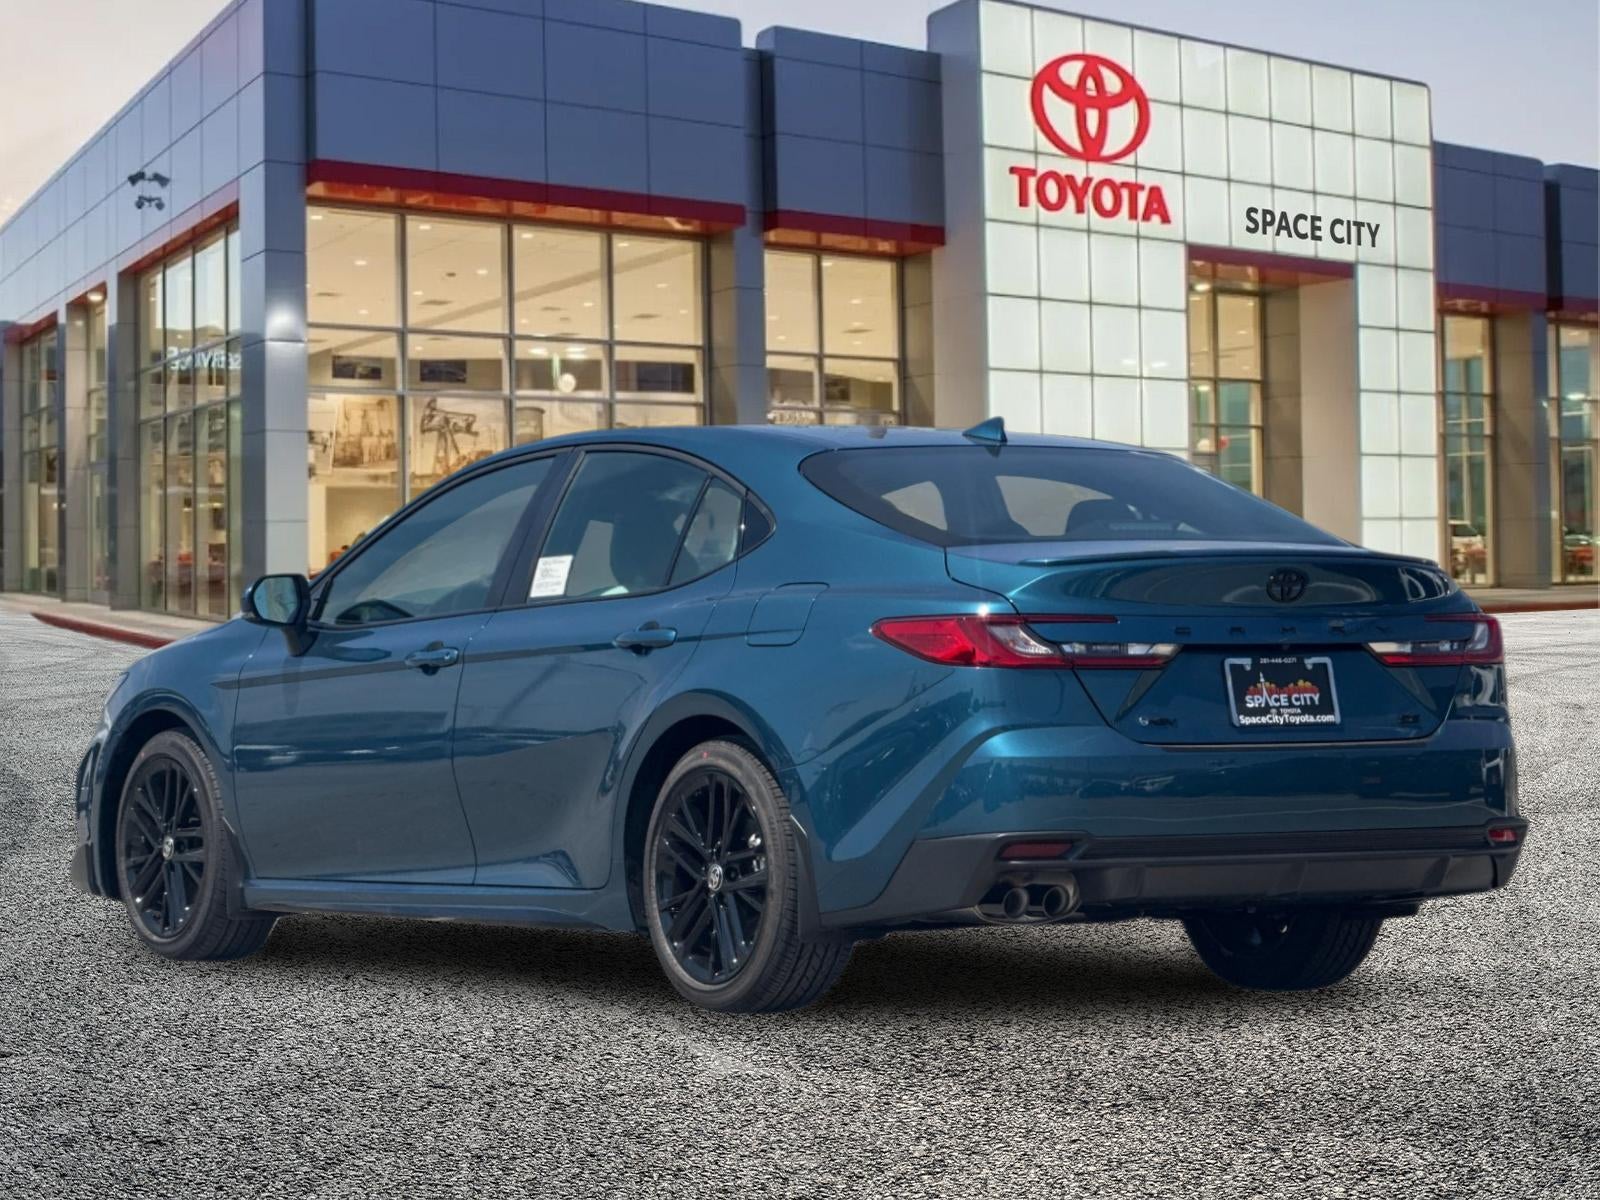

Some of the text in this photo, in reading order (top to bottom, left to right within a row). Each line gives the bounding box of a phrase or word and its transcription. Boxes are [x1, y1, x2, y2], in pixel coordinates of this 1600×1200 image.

[1009, 166, 1172, 225] TOYOTA
[1245, 206, 1381, 248] SPACE CITY
[1245, 692, 1320, 708] SPACE CITY
[1239, 714, 1335, 725] SpaceCityToyota.com
